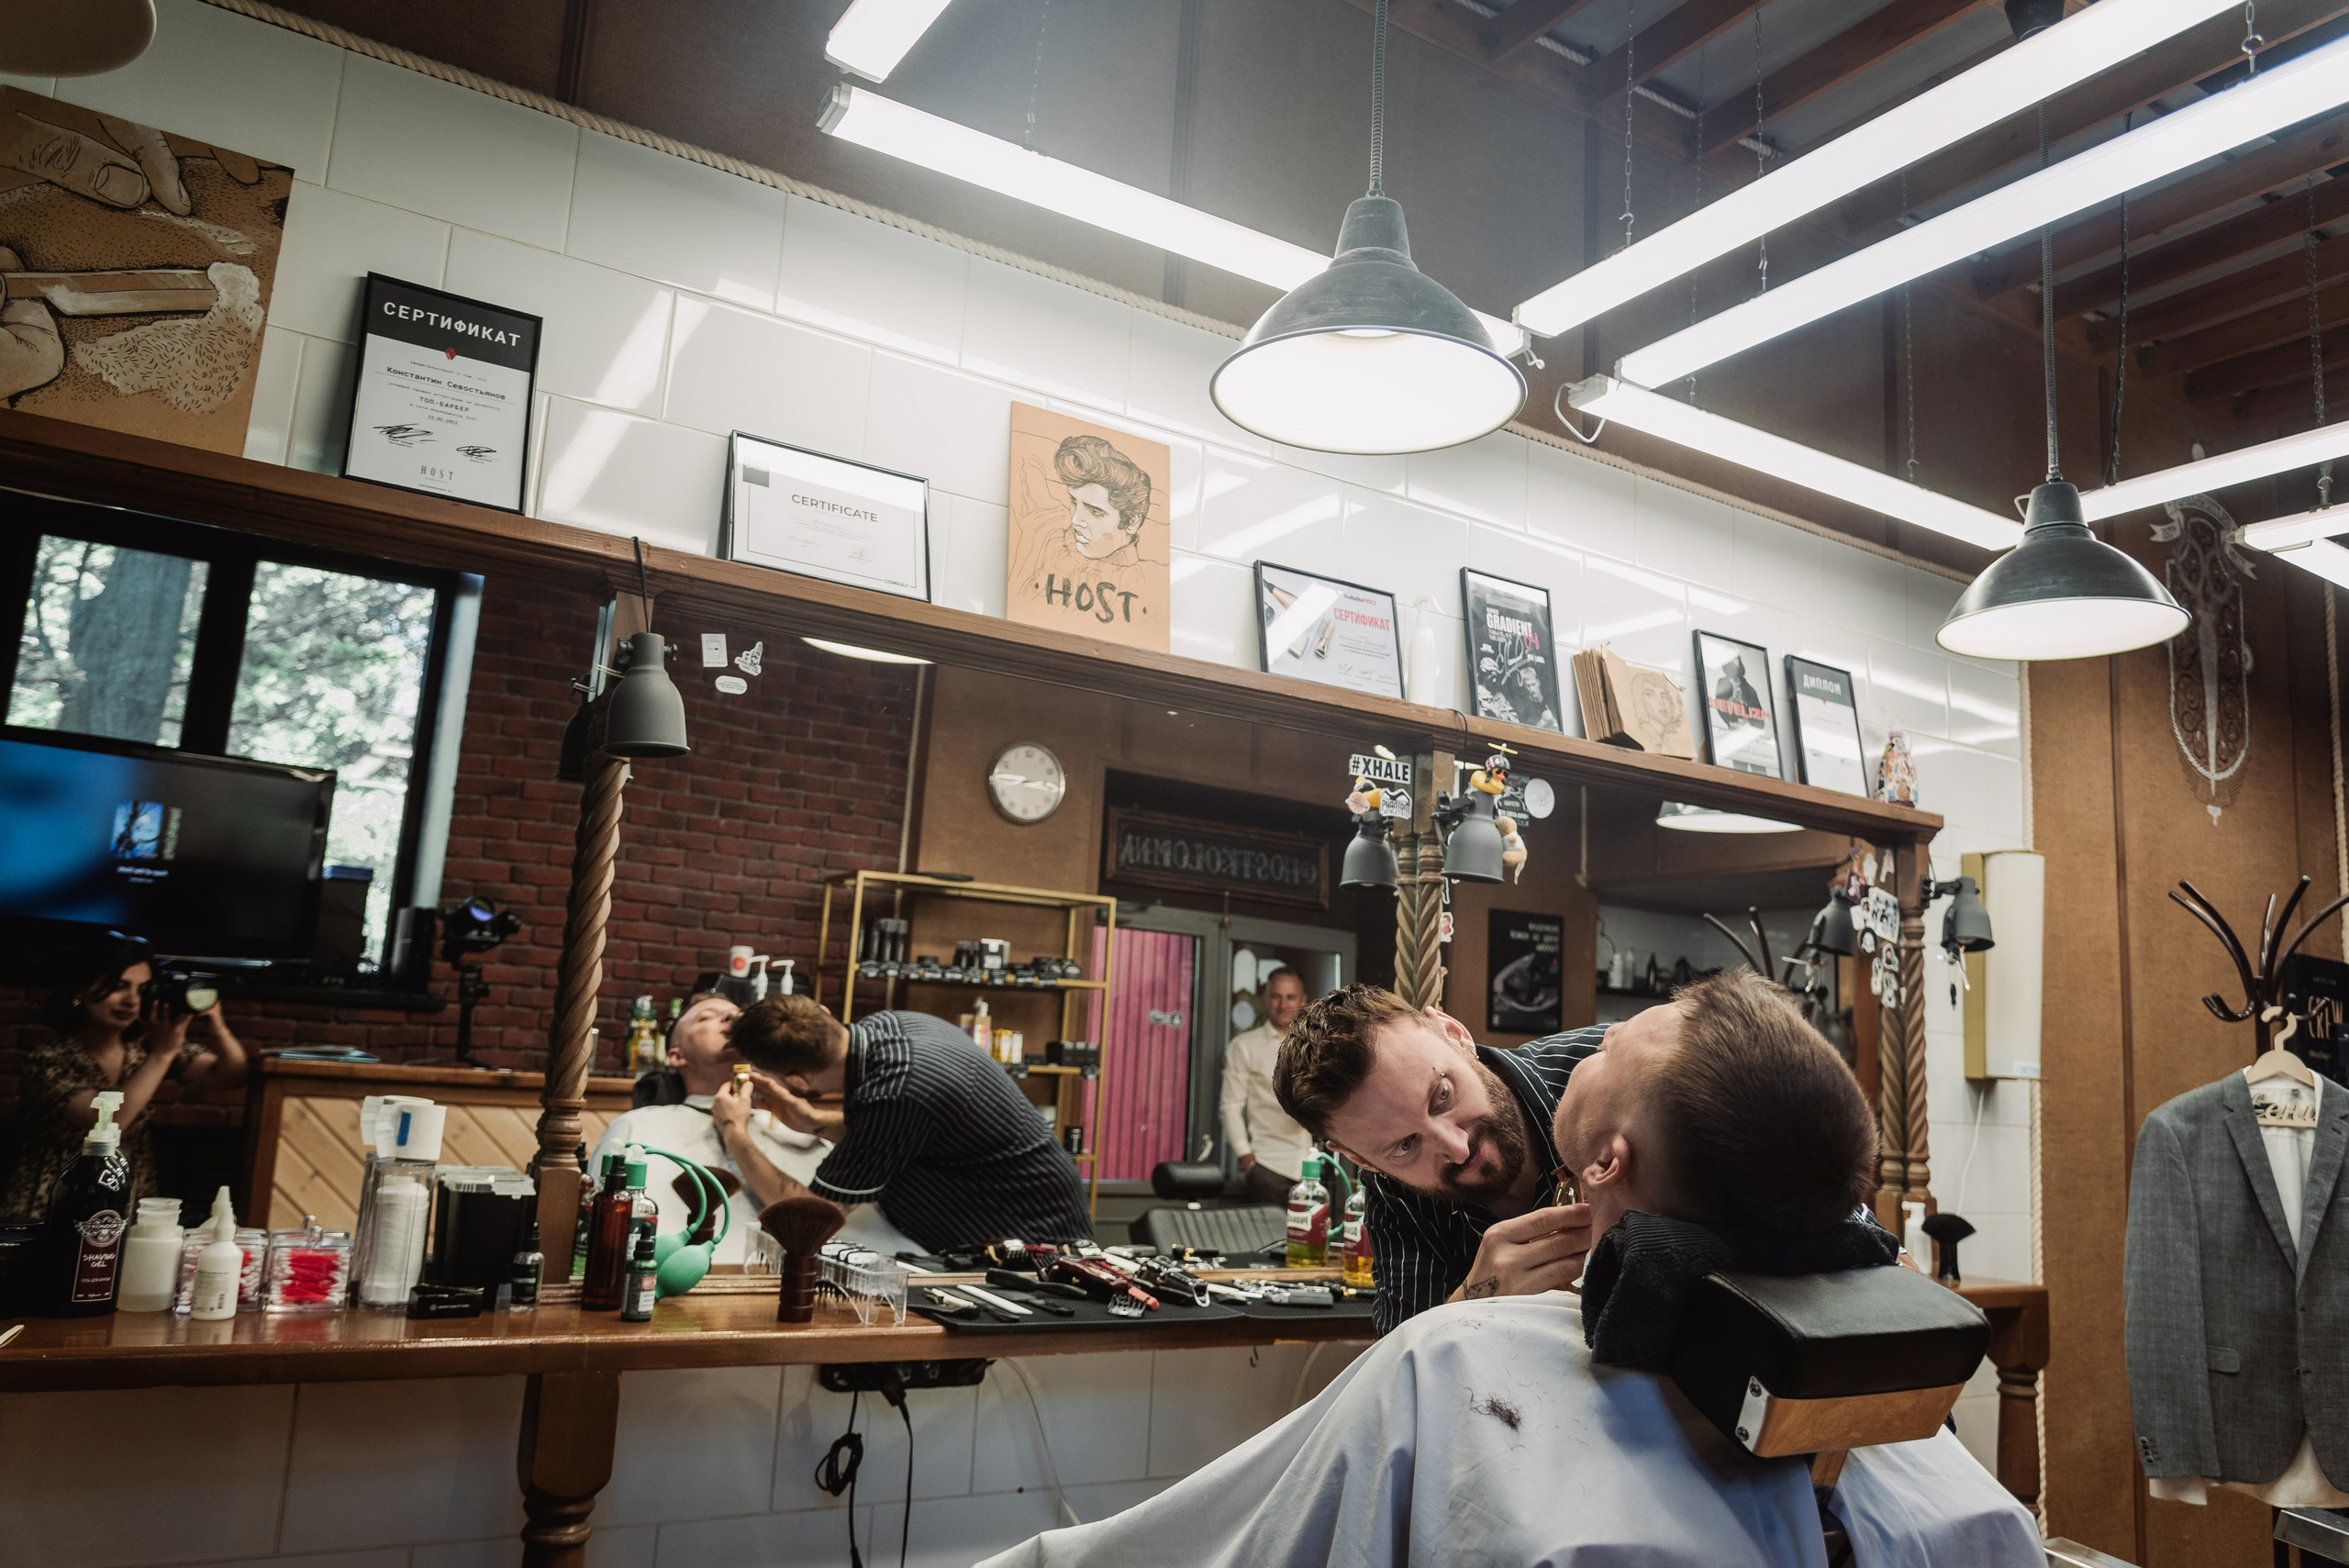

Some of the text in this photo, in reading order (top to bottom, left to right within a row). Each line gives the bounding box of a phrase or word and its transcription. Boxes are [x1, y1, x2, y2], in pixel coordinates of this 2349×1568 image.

[383, 302, 521, 347] СЕРТИФИКАТ
[386, 366, 507, 400] Константин Севостьянов
[419, 395, 470, 413] ТОП-БАРБЕР
[420, 465, 454, 480] HOST
[791, 494, 878, 522] CERTIFICATE
[1045, 573, 1140, 624] HOST
[1333, 607, 1390, 631] СЕРТИФИКАТ
[1486, 613, 1532, 637] GRADIENT
[1803, 674, 1842, 695] ДИПЛОМ
[1351, 757, 1409, 782] #XHALE
[1382, 799, 1410, 815] PHANTOM
[83, 1253, 116, 1262] SHAVING
